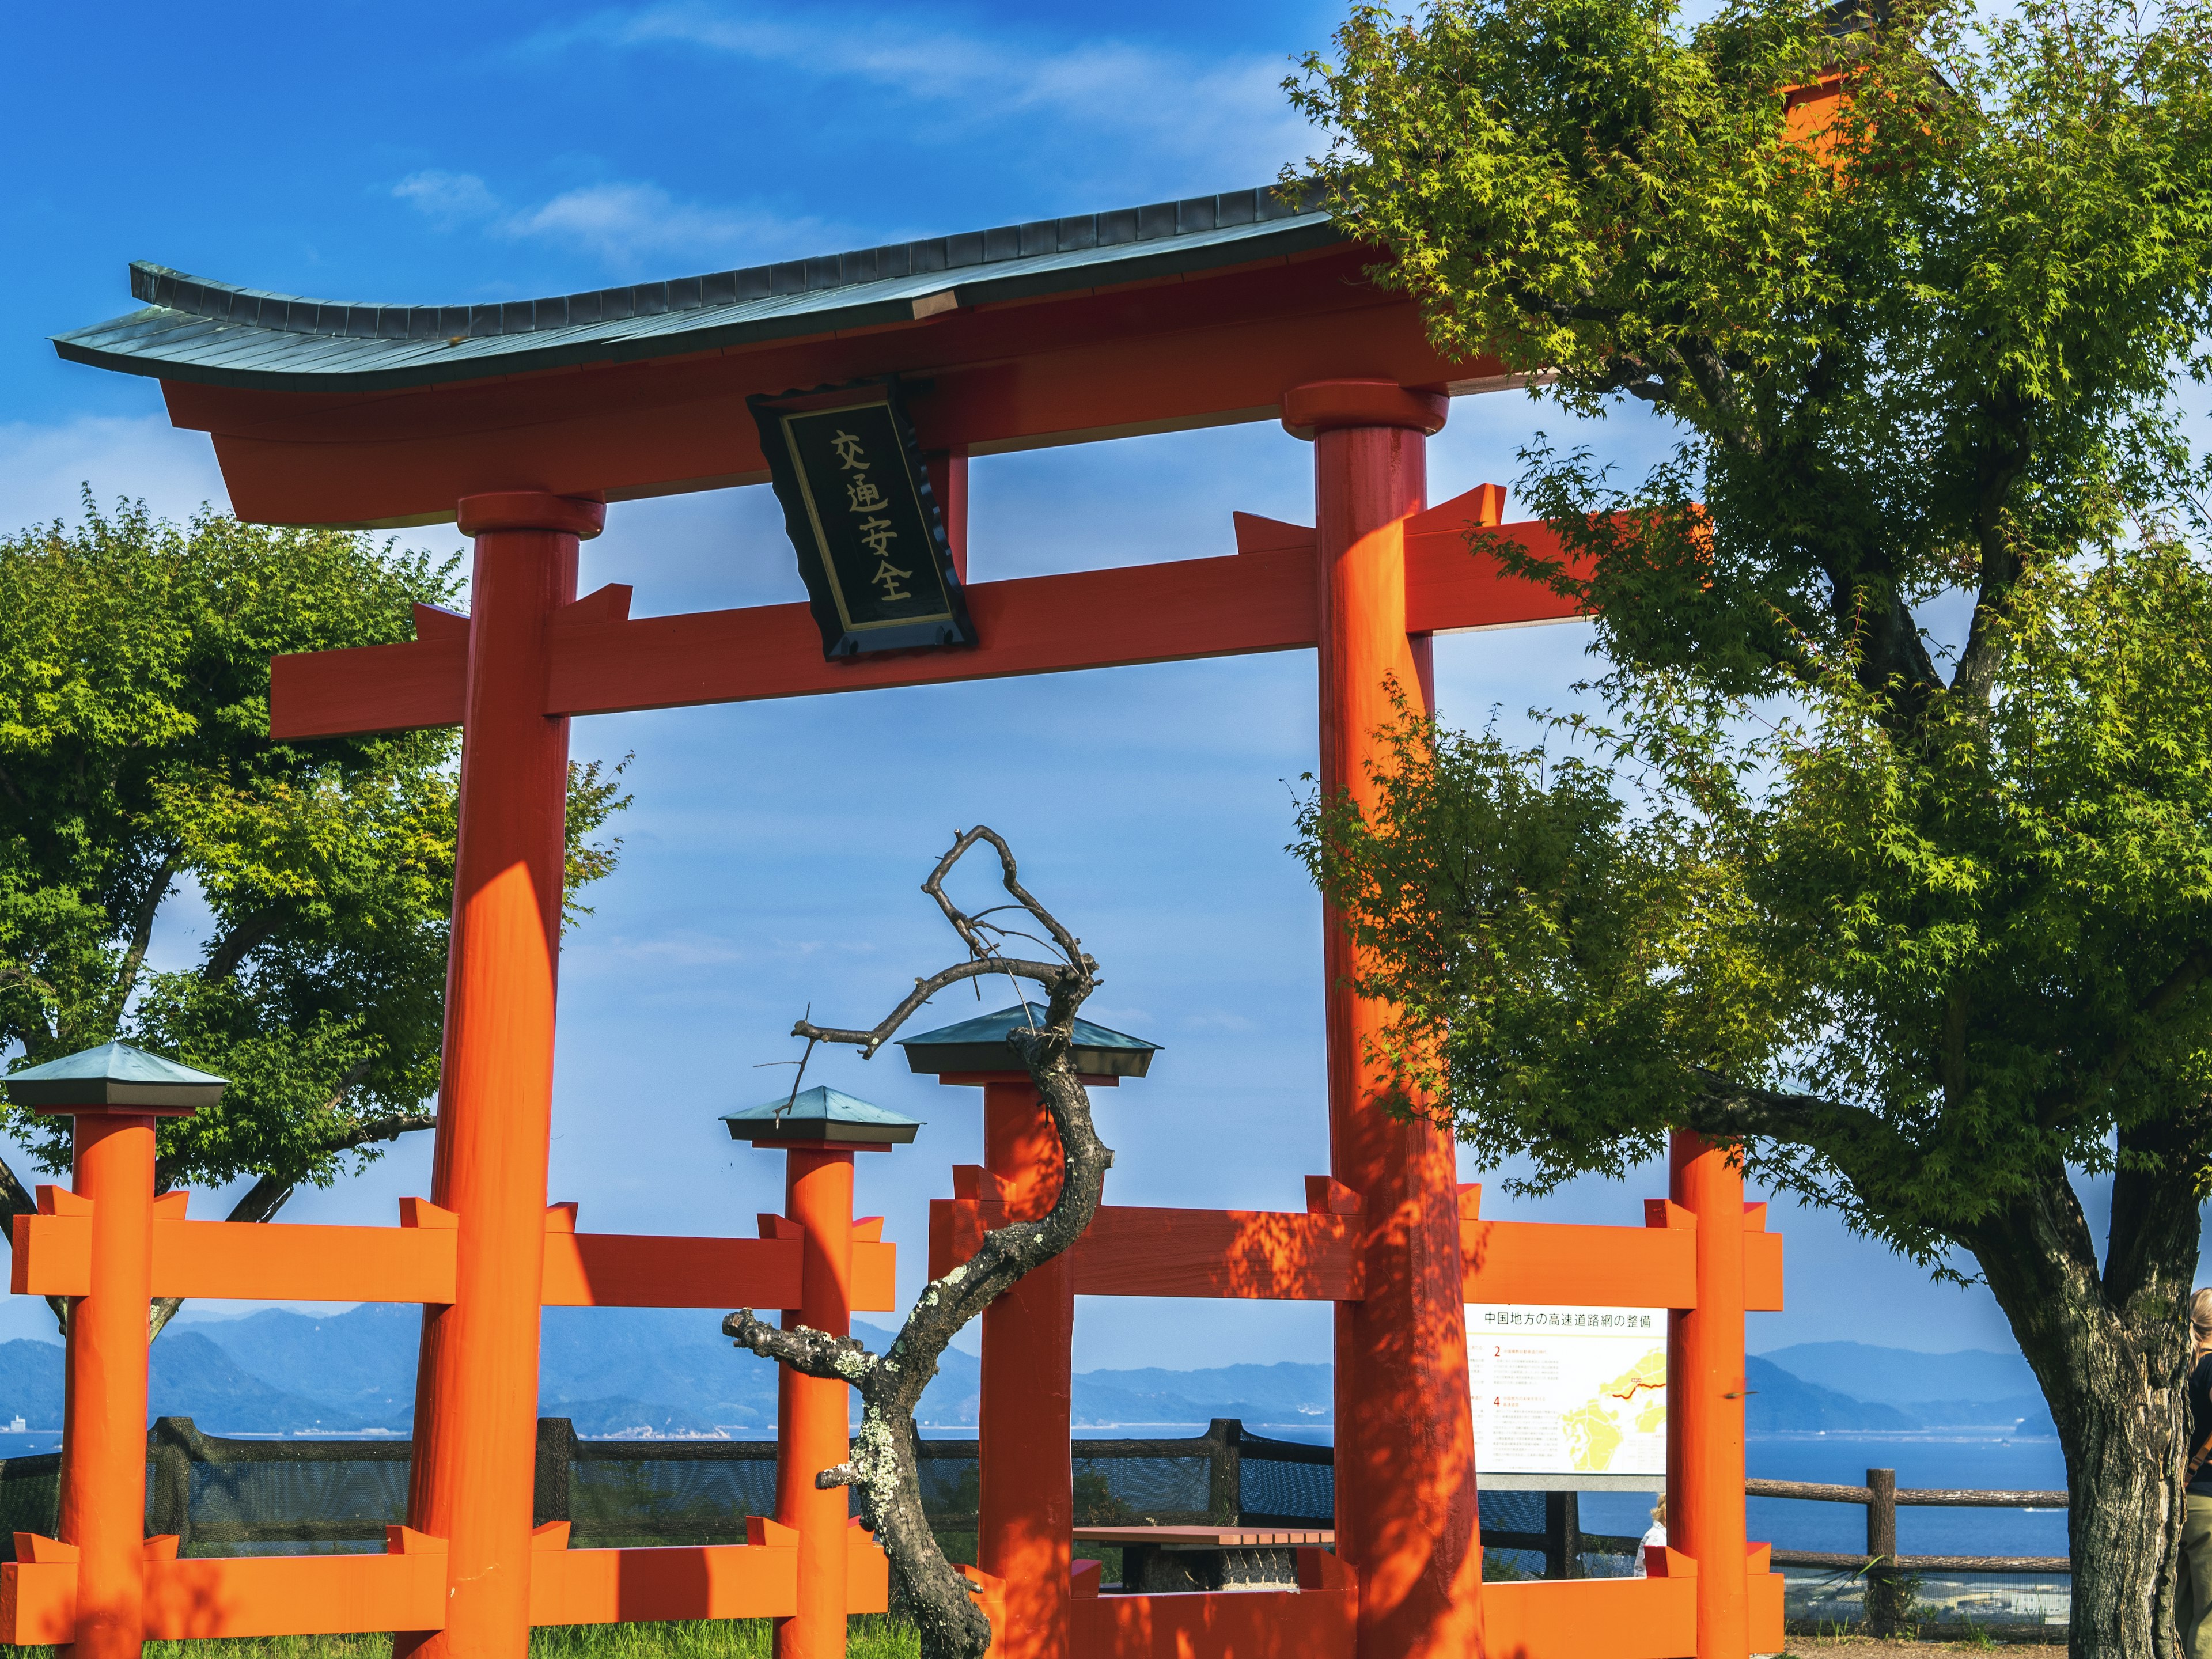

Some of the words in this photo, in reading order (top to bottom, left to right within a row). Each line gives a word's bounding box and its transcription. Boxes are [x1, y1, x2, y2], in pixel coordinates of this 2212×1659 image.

[831, 429, 913, 601] 交通安全
[1484, 1311, 1652, 1328] 中国地方の高速道路網の整備
[1494, 1346, 1501, 1357] 2
[1494, 1396, 1500, 1407] 4
